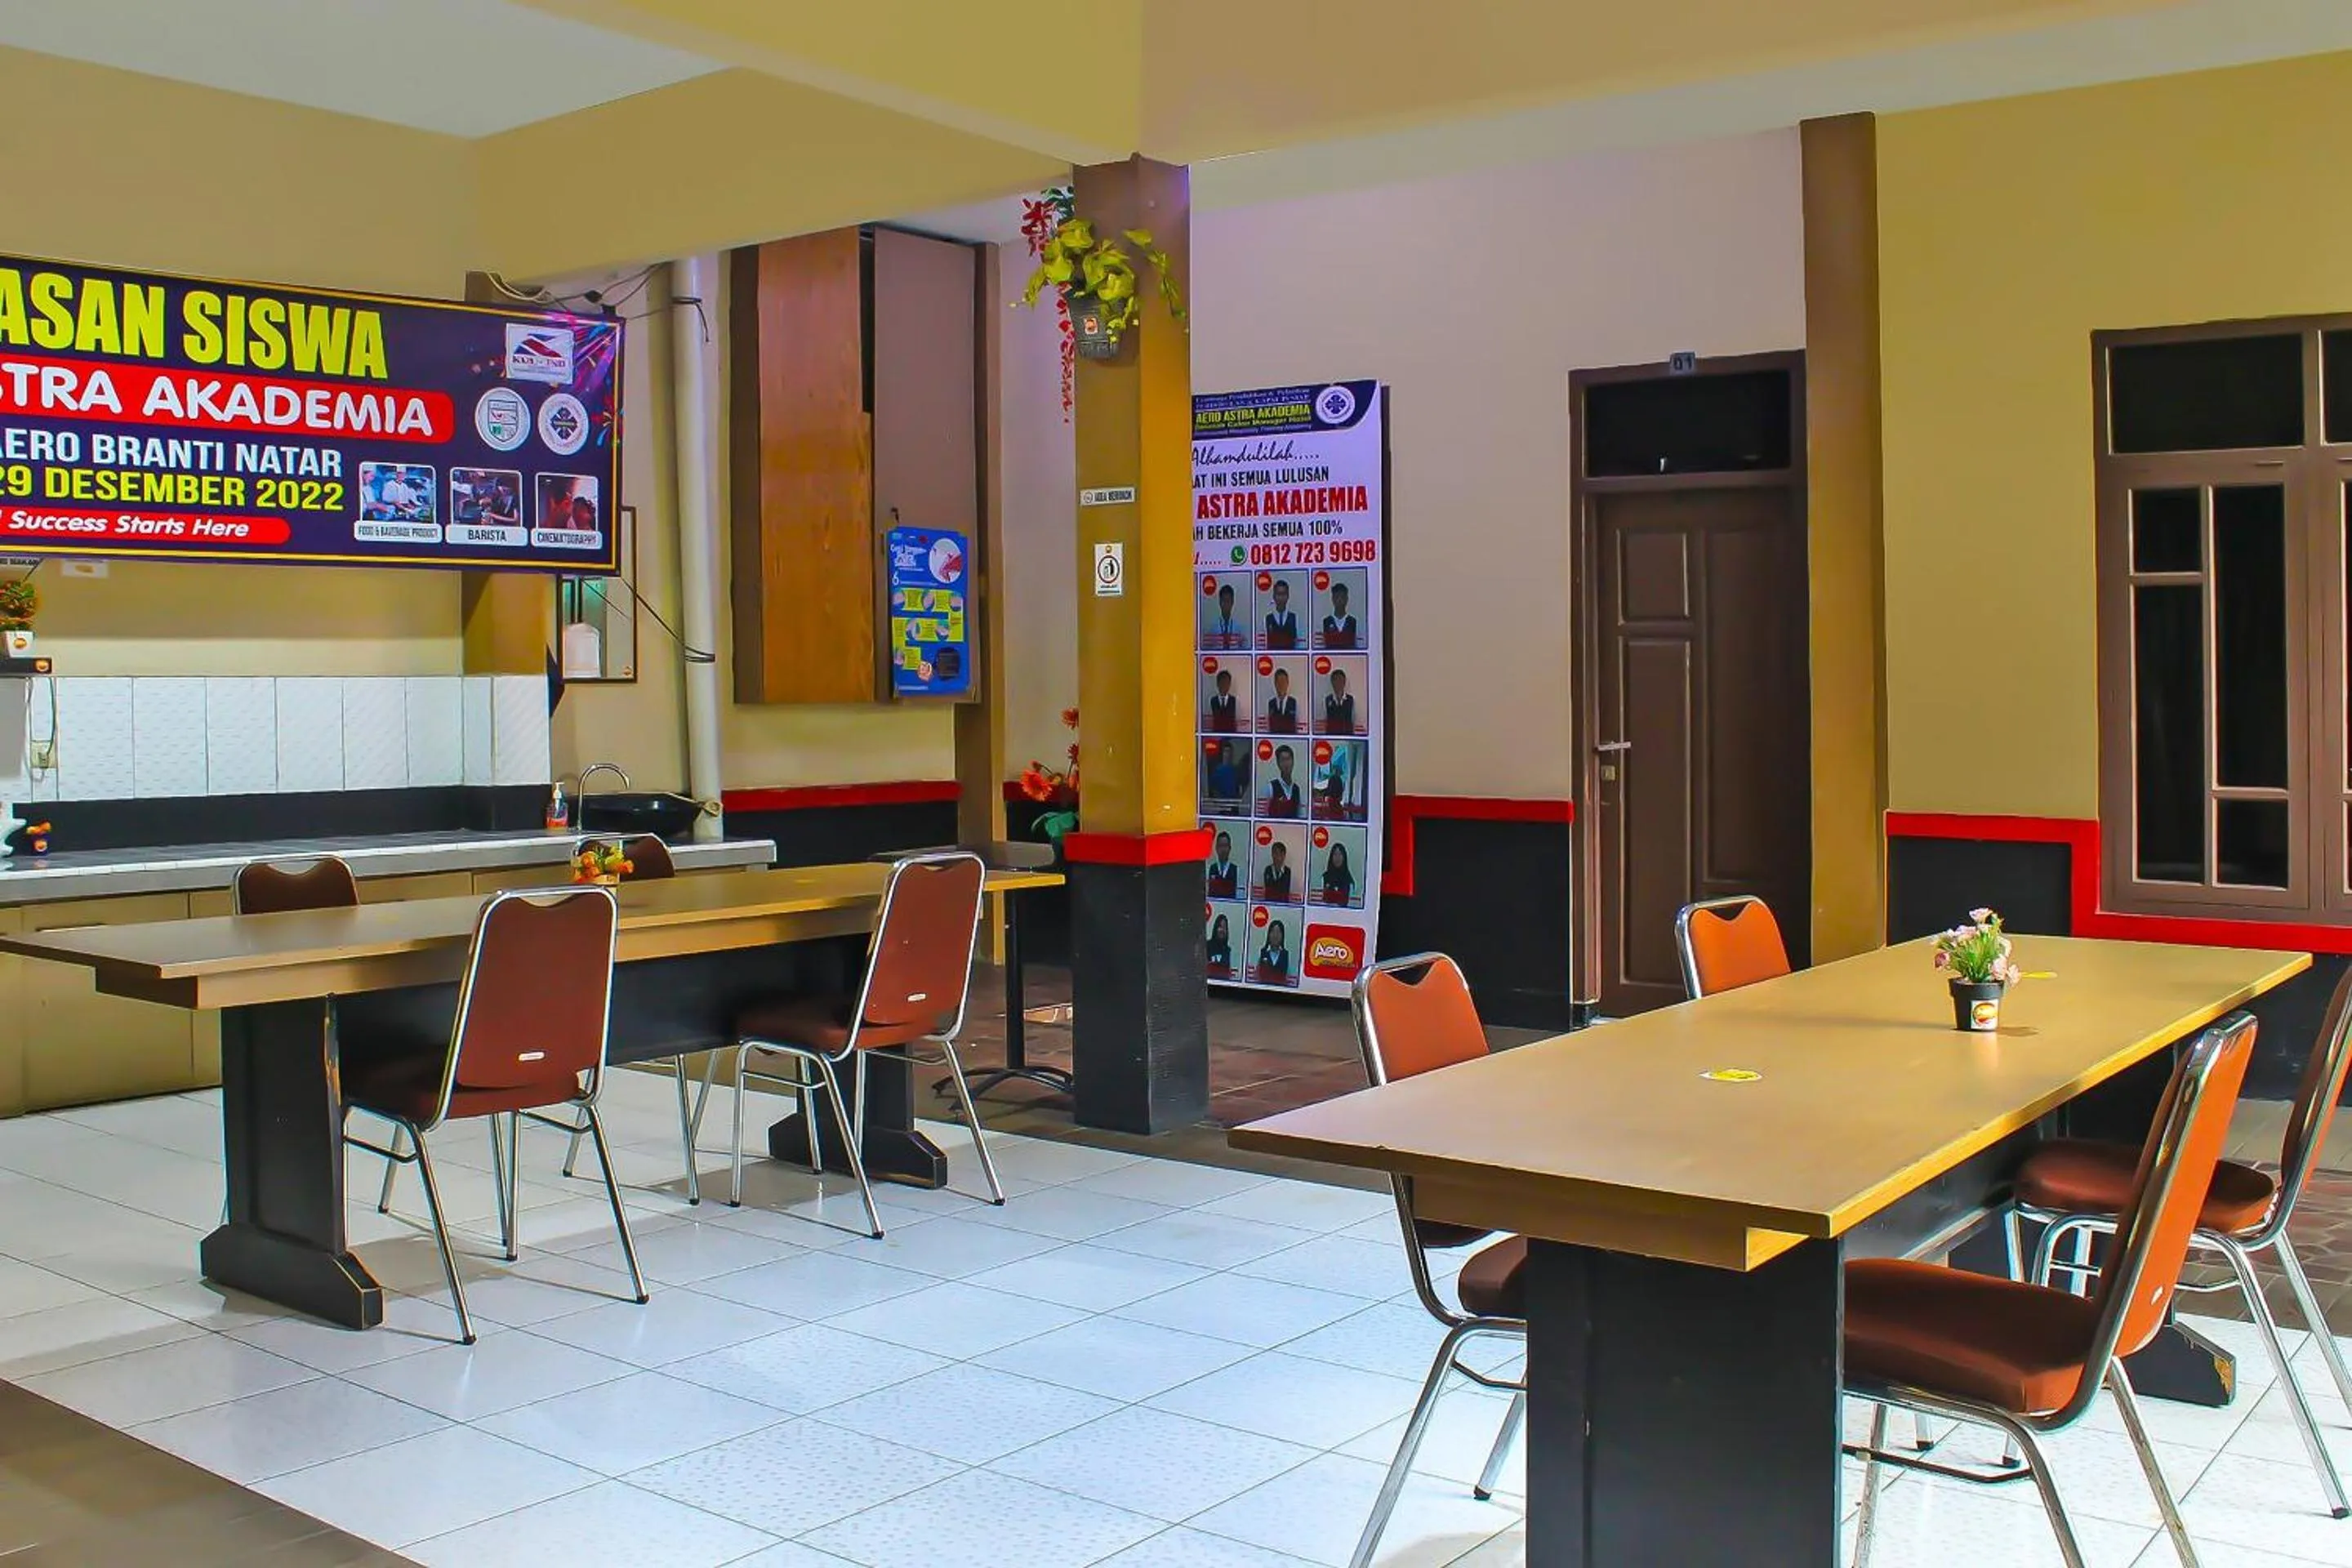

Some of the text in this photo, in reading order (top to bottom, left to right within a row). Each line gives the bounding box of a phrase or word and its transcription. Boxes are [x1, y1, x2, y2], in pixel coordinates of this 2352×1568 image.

[183, 291, 388, 379] SISWA
[0, 363, 122, 414] TRA
[142, 376, 434, 437] AKADEMIA
[1223, 408, 1255, 421] ASTRA
[1258, 403, 1311, 418] AKADEMIA
[0, 427, 341, 477] ERO BRANTI NATAR
[0, 465, 344, 510] 9 DESEMBER 2022
[1211, 473, 1227, 488] INI
[1231, 470, 1271, 487] SEMUA
[1276, 466, 1329, 483] LULUSAN
[1197, 486, 1368, 519] ASTRA AKADEMIA
[9, 510, 107, 532] Success
[114, 515, 185, 536] Starts
[192, 519, 249, 537] Here
[467, 529, 506, 542] BARISTA
[1208, 523, 1258, 540] BEKERJA
[1263, 522, 1303, 538] SEMUA
[1308, 520, 1343, 536] 100%
[1250, 544, 1290, 566] 0812
[1295, 542, 1325, 564] 723
[1330, 540, 1376, 563] 9698
[1315, 942, 1348, 960] Aero
